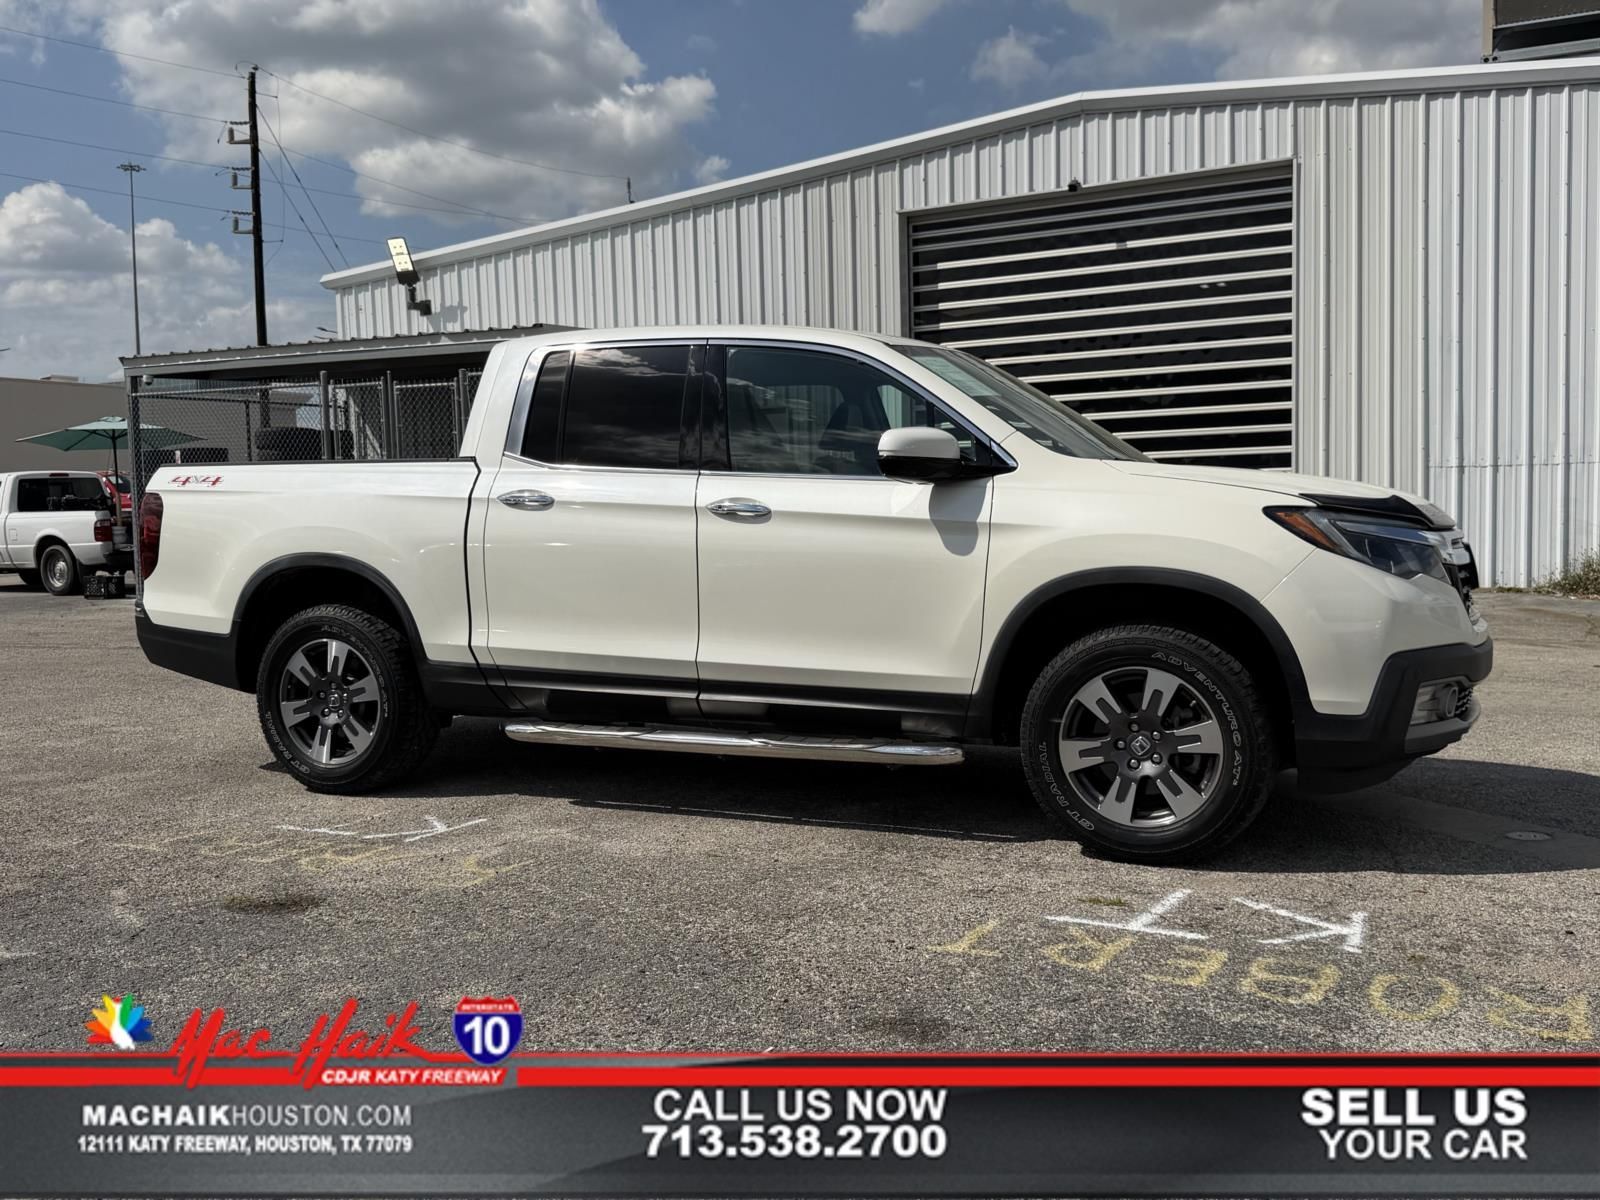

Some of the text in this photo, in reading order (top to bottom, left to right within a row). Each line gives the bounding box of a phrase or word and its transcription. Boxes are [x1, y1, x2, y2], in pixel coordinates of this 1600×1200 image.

[1151, 651, 1242, 747] ADVENTURO
[1039, 741, 1095, 831] GT RADIAL
